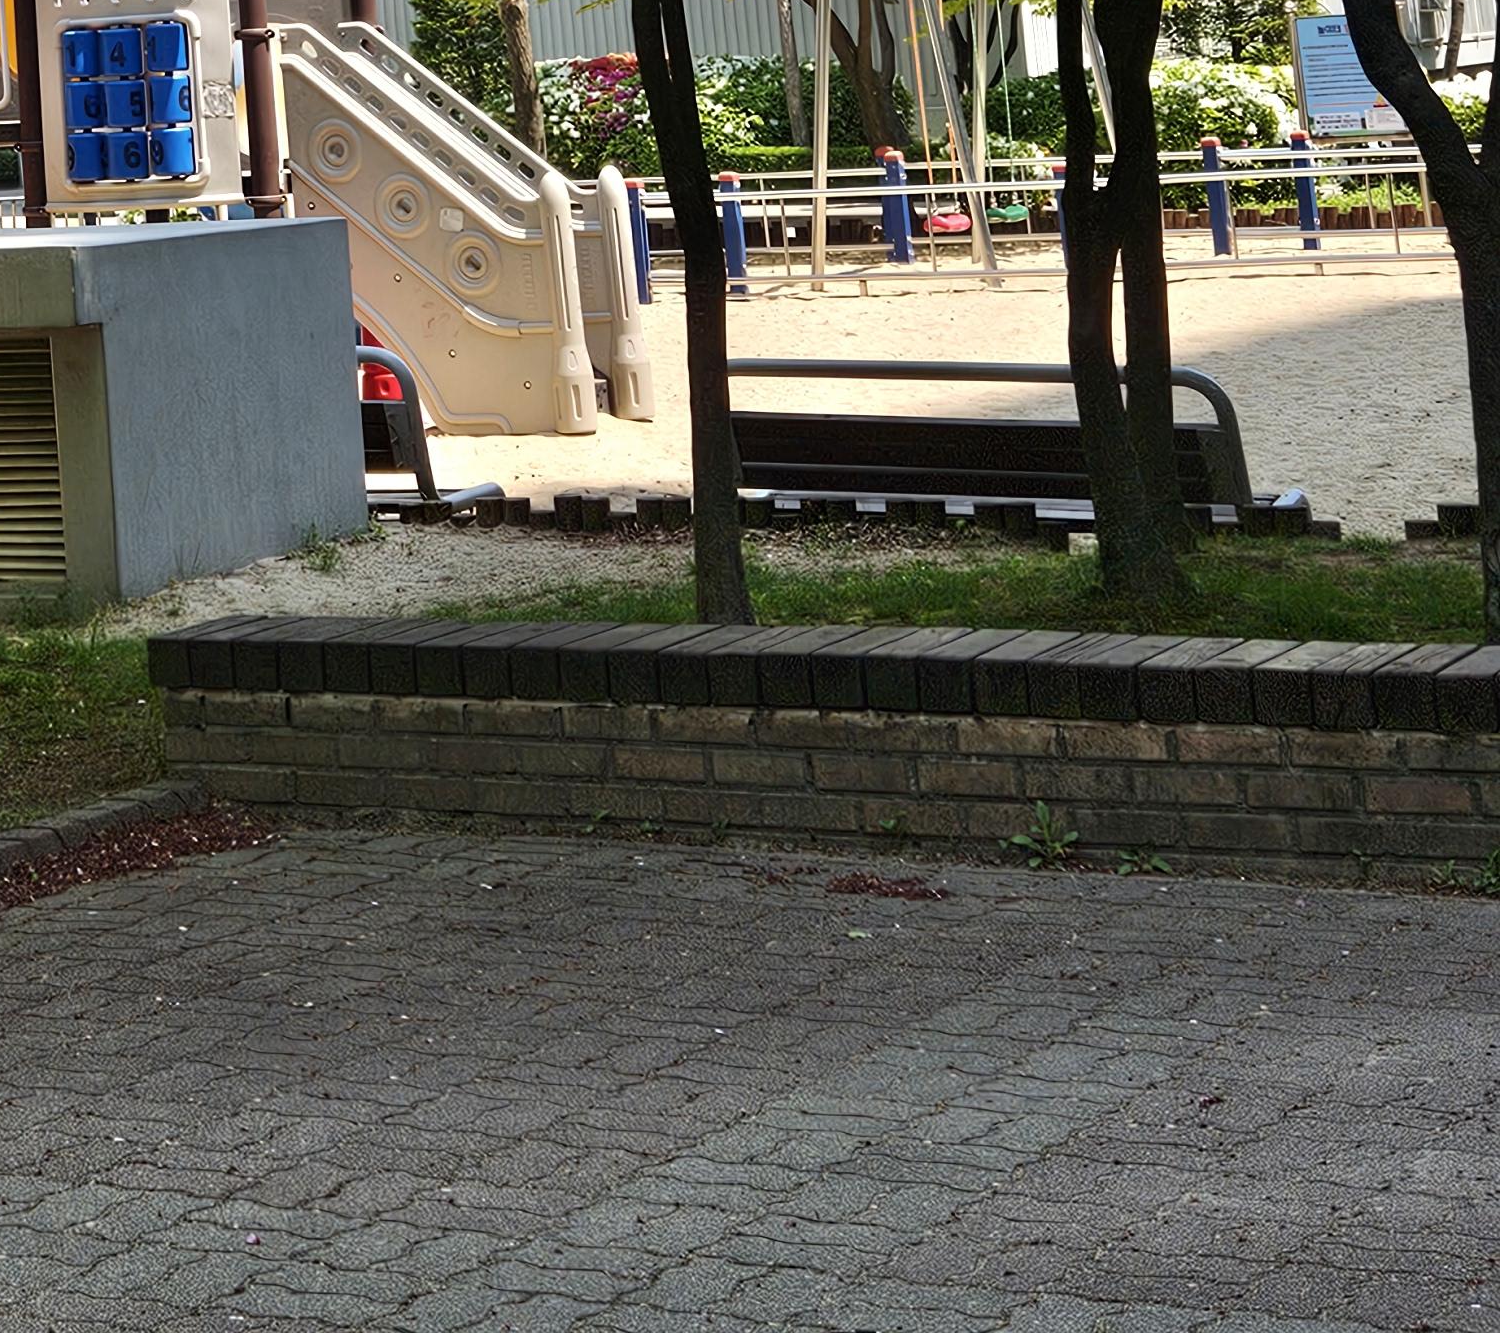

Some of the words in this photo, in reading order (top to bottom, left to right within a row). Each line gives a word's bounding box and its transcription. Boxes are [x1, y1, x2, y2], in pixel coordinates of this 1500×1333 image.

[67, 41, 76, 68] 1
[110, 40, 126, 67] 4
[130, 90, 145, 117] 5
[124, 141, 141, 168] 6
